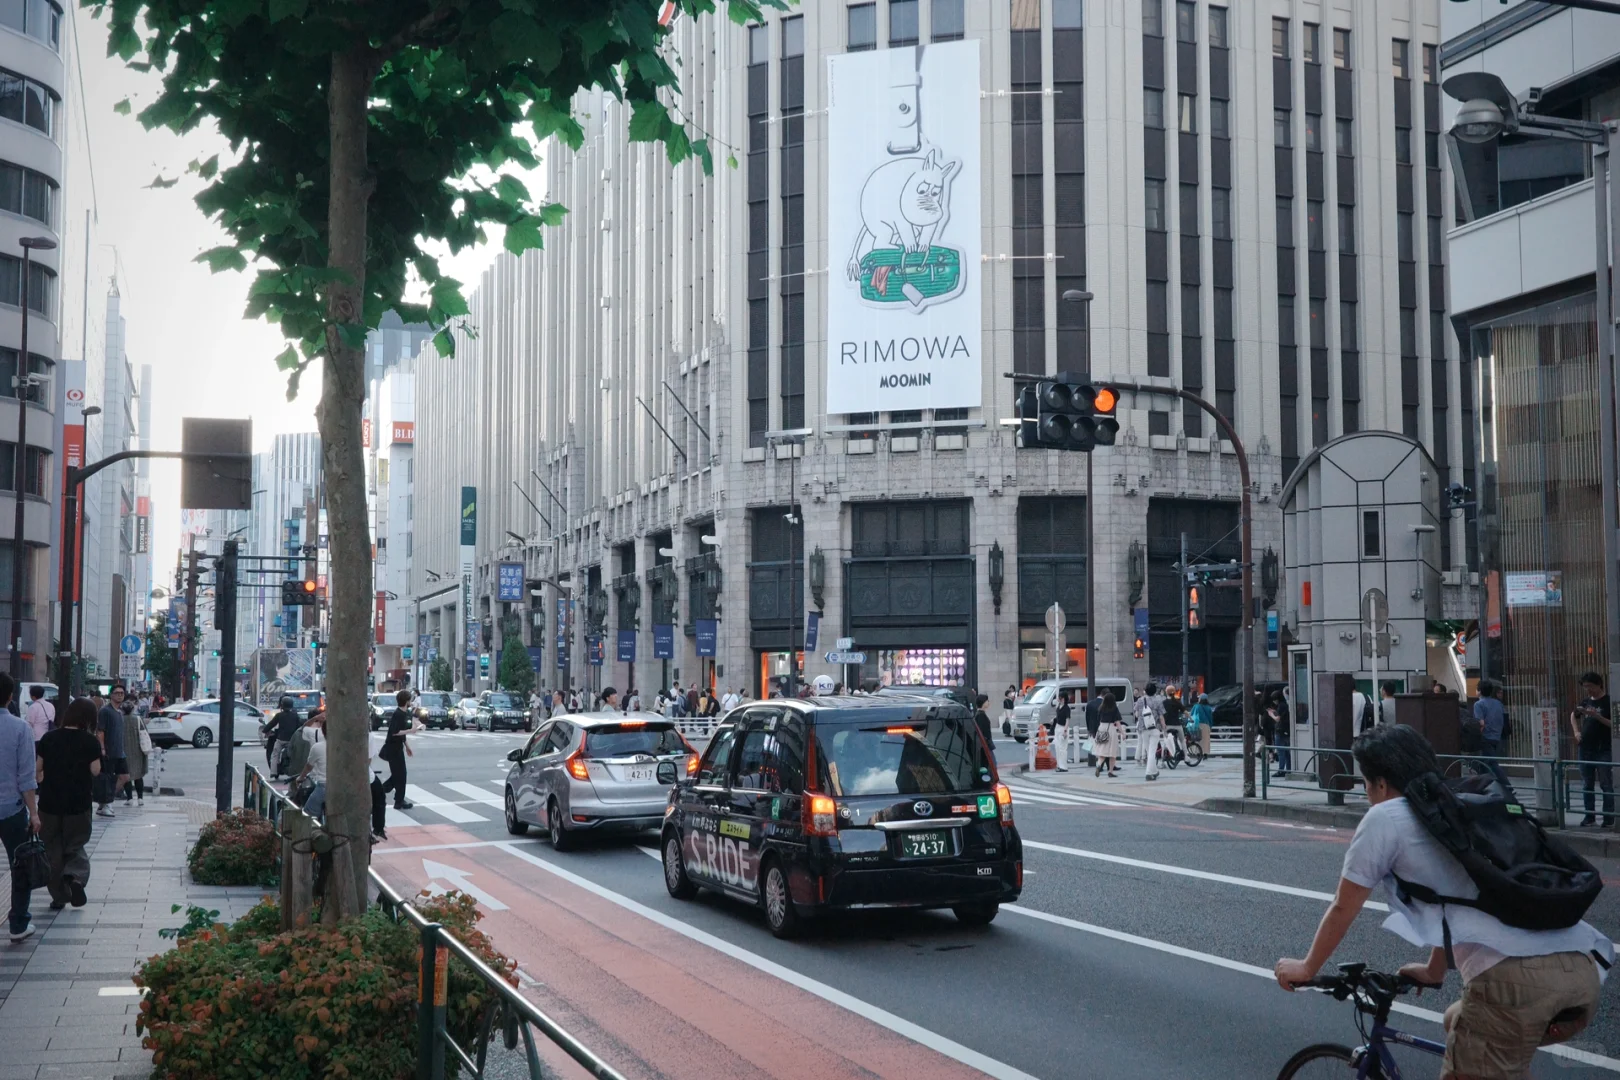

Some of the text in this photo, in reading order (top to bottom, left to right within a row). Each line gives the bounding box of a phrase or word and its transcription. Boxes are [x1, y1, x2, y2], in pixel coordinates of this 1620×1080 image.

[841, 334, 970, 365] RIMOWA
[879, 372, 931, 388] MOOMIN
[631, 769, 653, 779] 42-17
[912, 840, 945, 856] 24-37
[1395, 1031, 1414, 1043] GIOS
